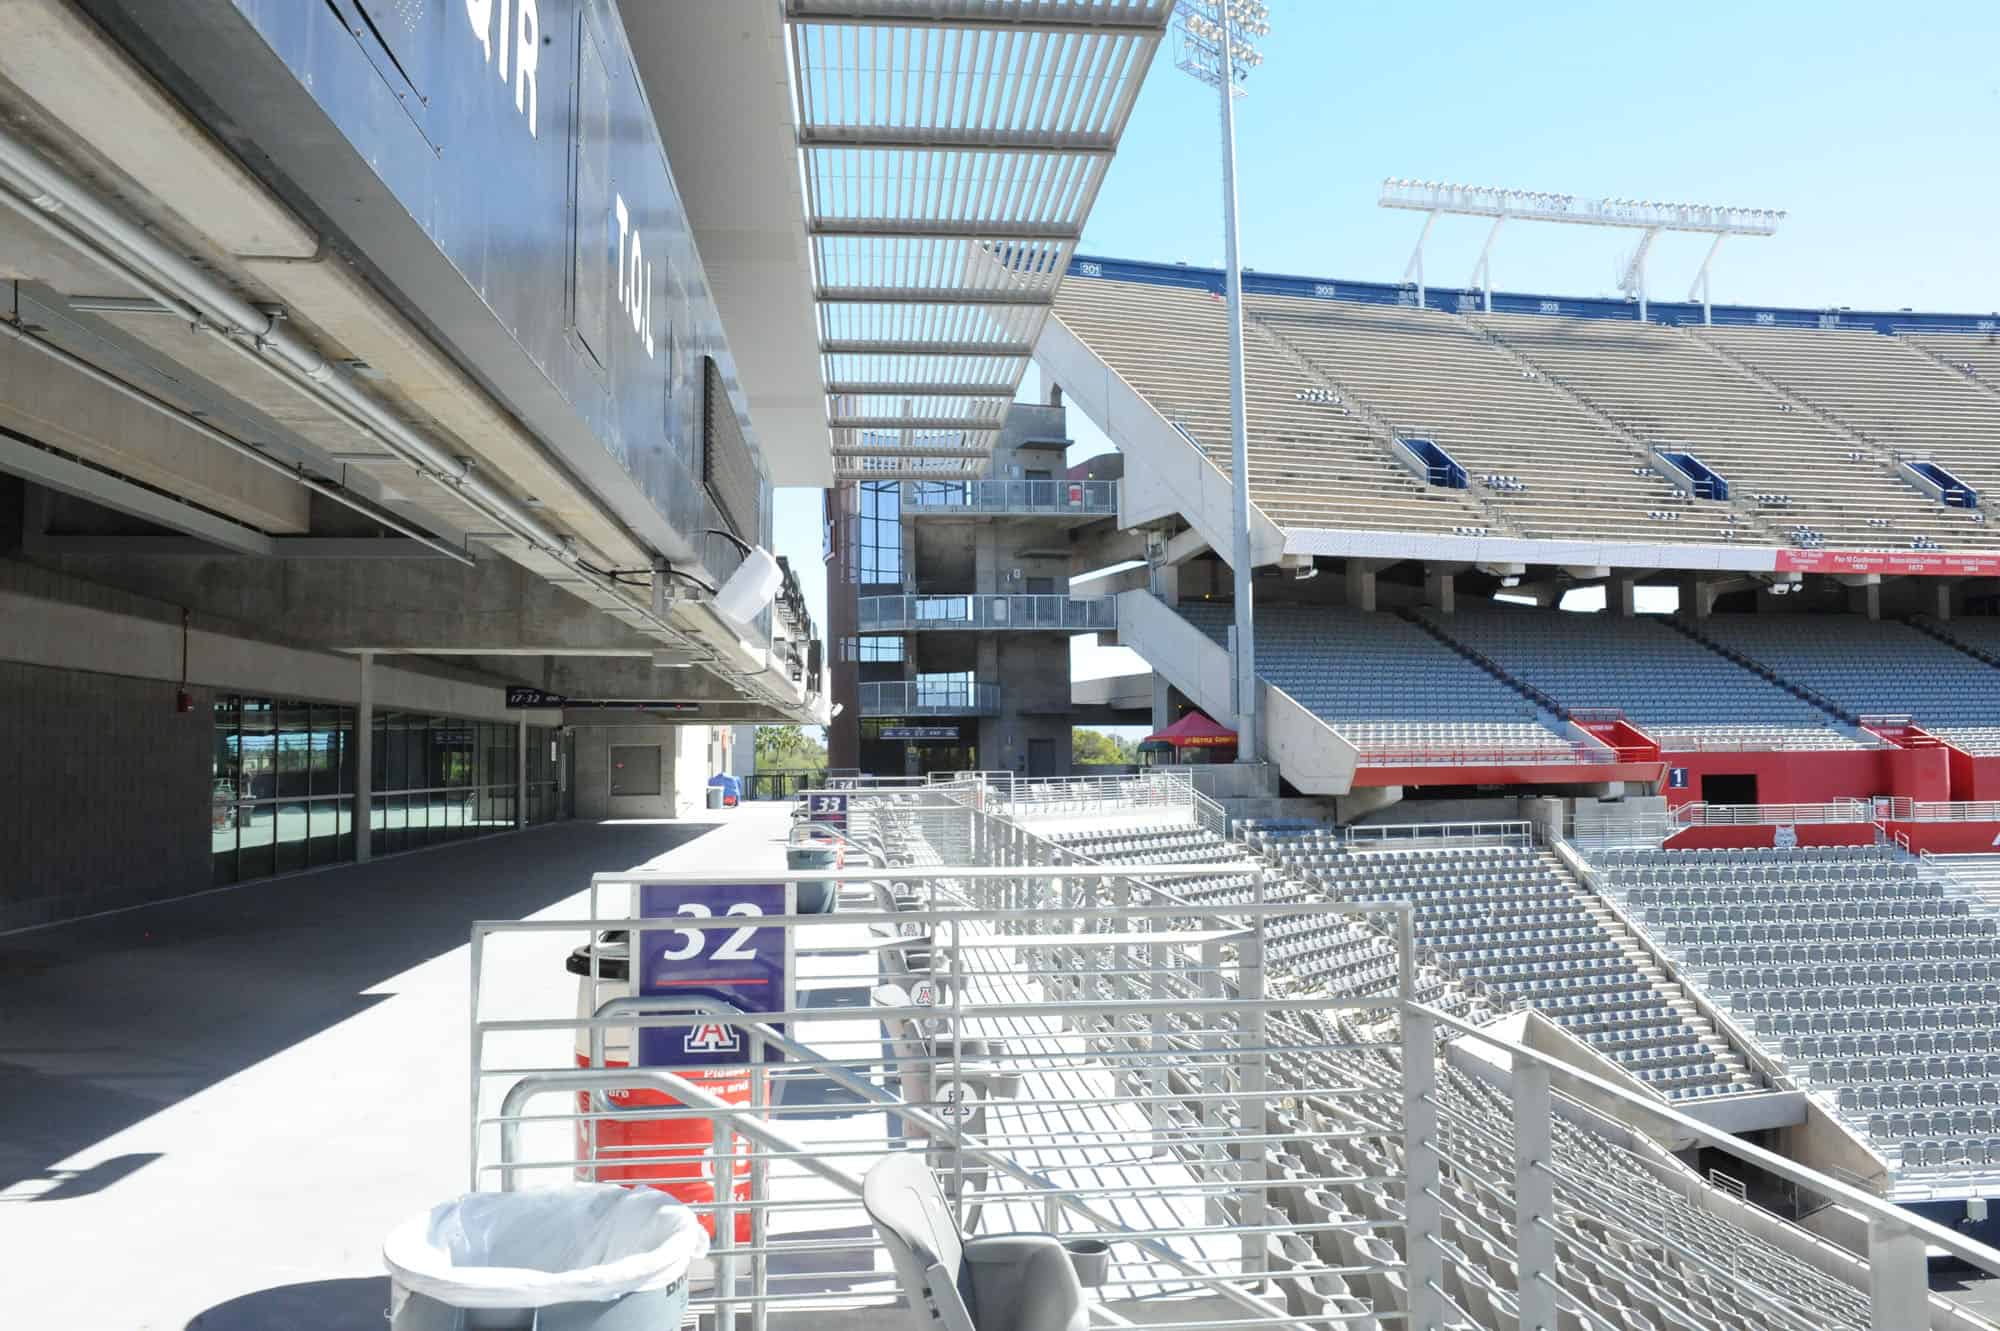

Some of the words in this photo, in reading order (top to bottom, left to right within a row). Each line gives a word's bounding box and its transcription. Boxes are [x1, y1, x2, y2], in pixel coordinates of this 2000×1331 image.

[1673, 769, 1682, 787] 1
[816, 797, 841, 813] 33
[663, 902, 764, 962] 32
